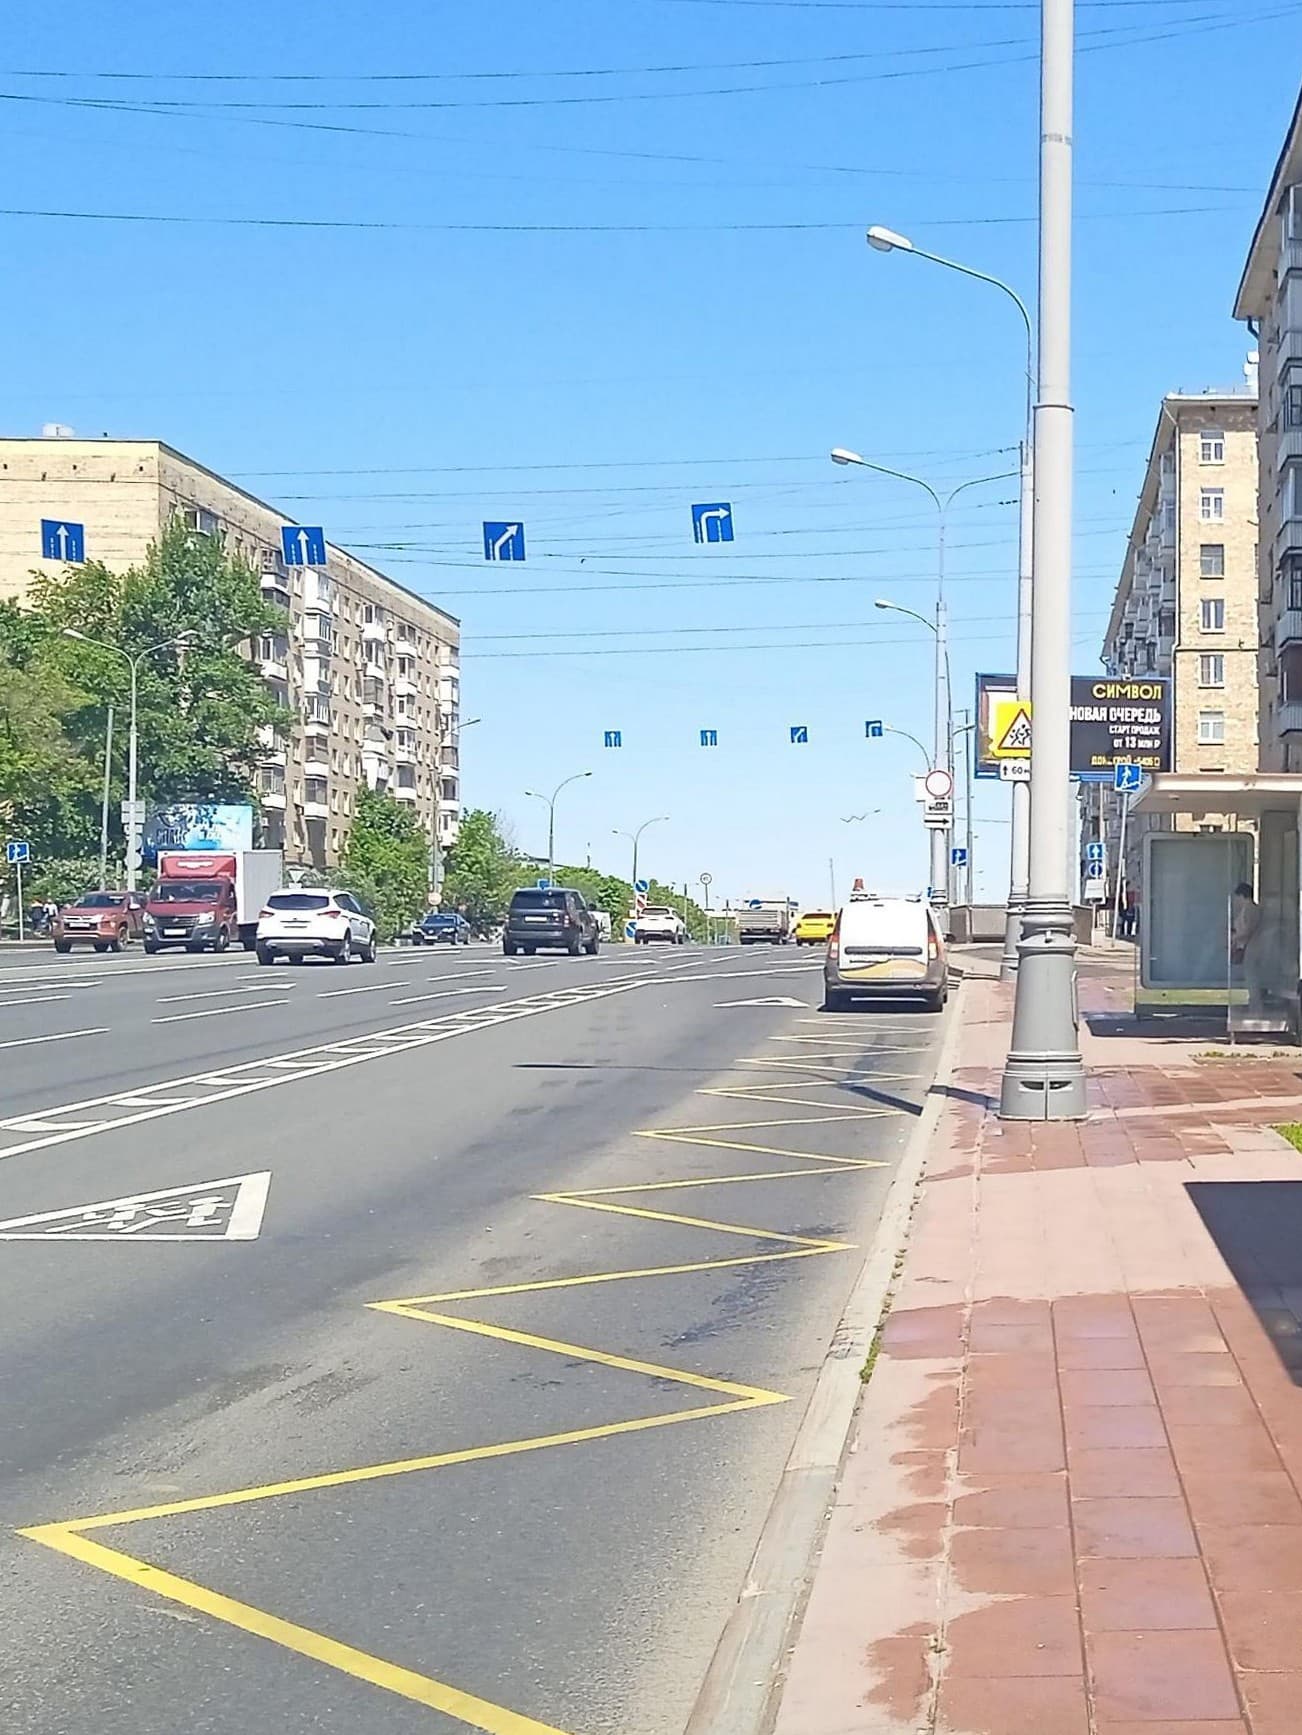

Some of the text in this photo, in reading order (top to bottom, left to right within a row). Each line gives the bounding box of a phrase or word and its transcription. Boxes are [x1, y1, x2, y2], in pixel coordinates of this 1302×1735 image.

[1092, 684, 1162, 699] СИМВОЛ
[1070, 706, 1161, 723] НОВАЯ ОЧЕРЕДЬ
[1125, 736, 1137, 748] 13
[1011, 766, 1023, 775] 60
